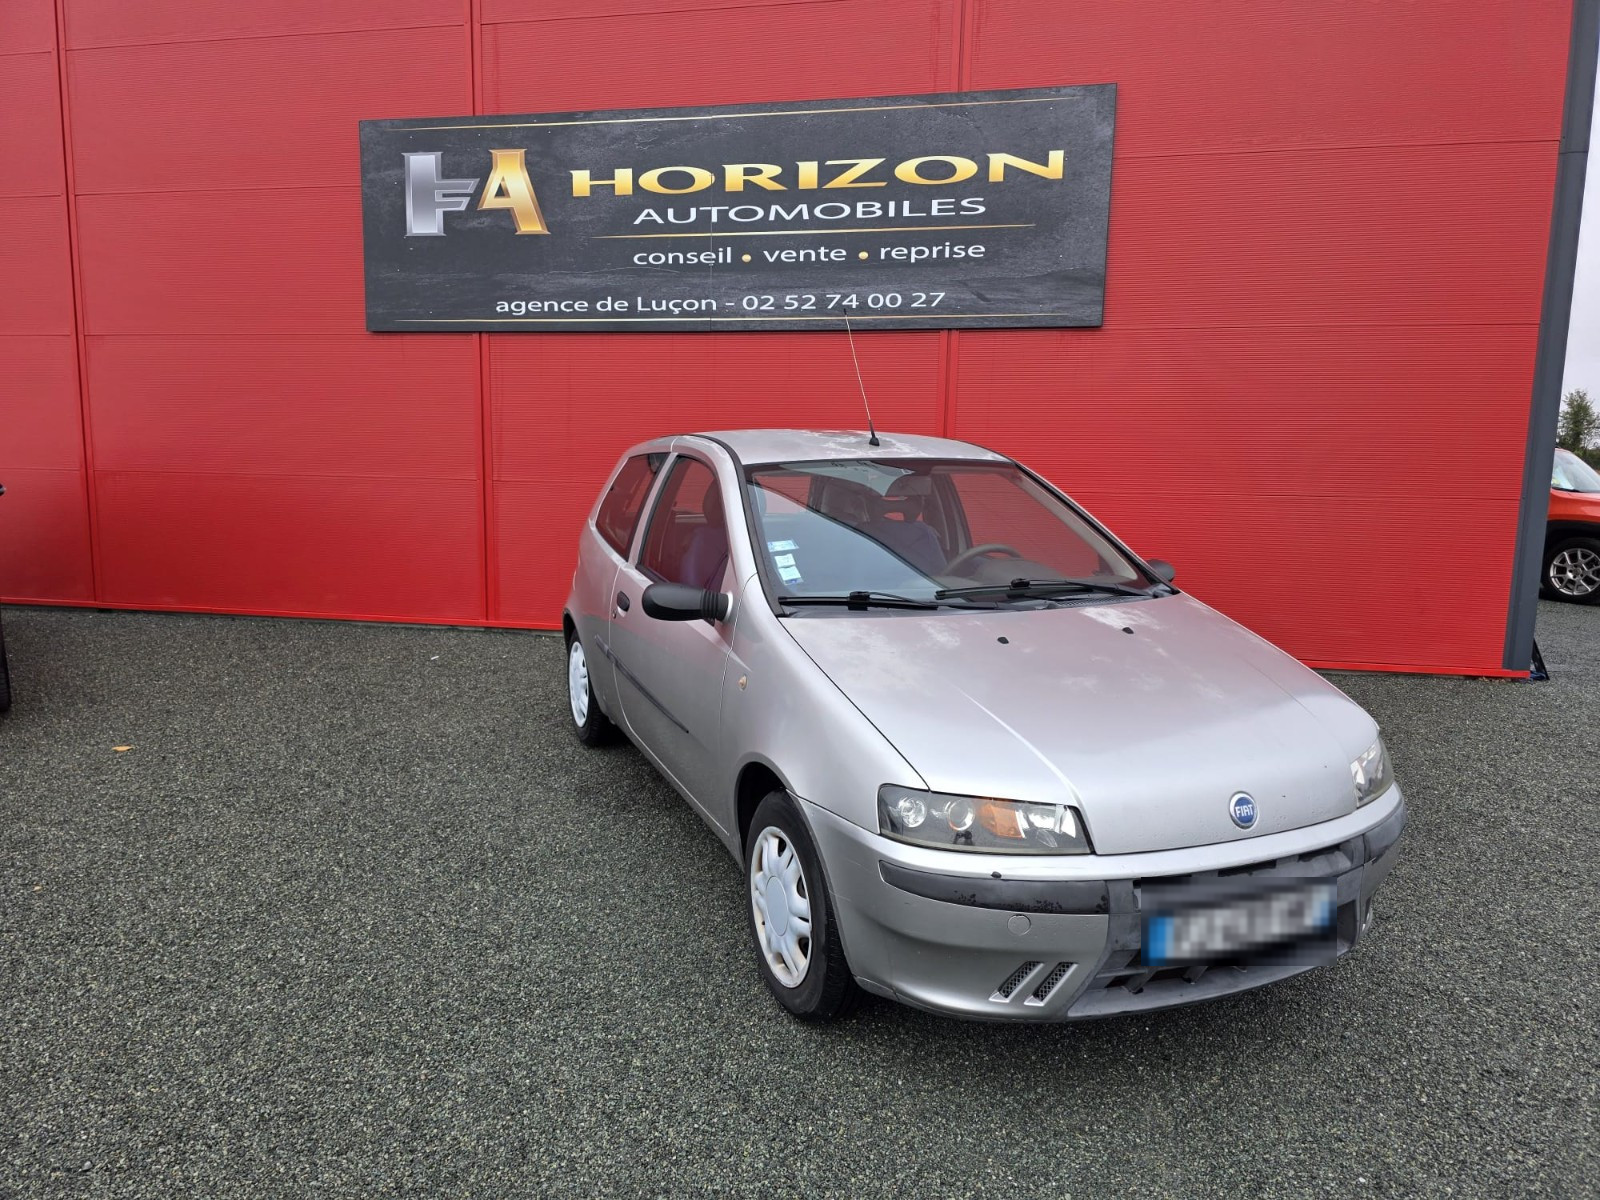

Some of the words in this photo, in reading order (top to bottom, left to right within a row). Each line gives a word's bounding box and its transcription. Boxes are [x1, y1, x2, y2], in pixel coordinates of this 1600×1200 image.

[569, 150, 1065, 197] HORIZON
[633, 197, 987, 225] AUTOMOBILES
[633, 247, 732, 265] conseil
[763, 246, 847, 263] vente
[880, 242, 986, 263] reprise
[495, 299, 589, 317] agence
[596, 296, 629, 312] de
[637, 296, 718, 315] Luçon
[742, 295, 776, 311] 02
[784, 295, 817, 310] 52
[825, 294, 860, 310] 74
[867, 293, 902, 309] 00
[911, 292, 946, 307] 27
[1235, 804, 1254, 818] FIAT
